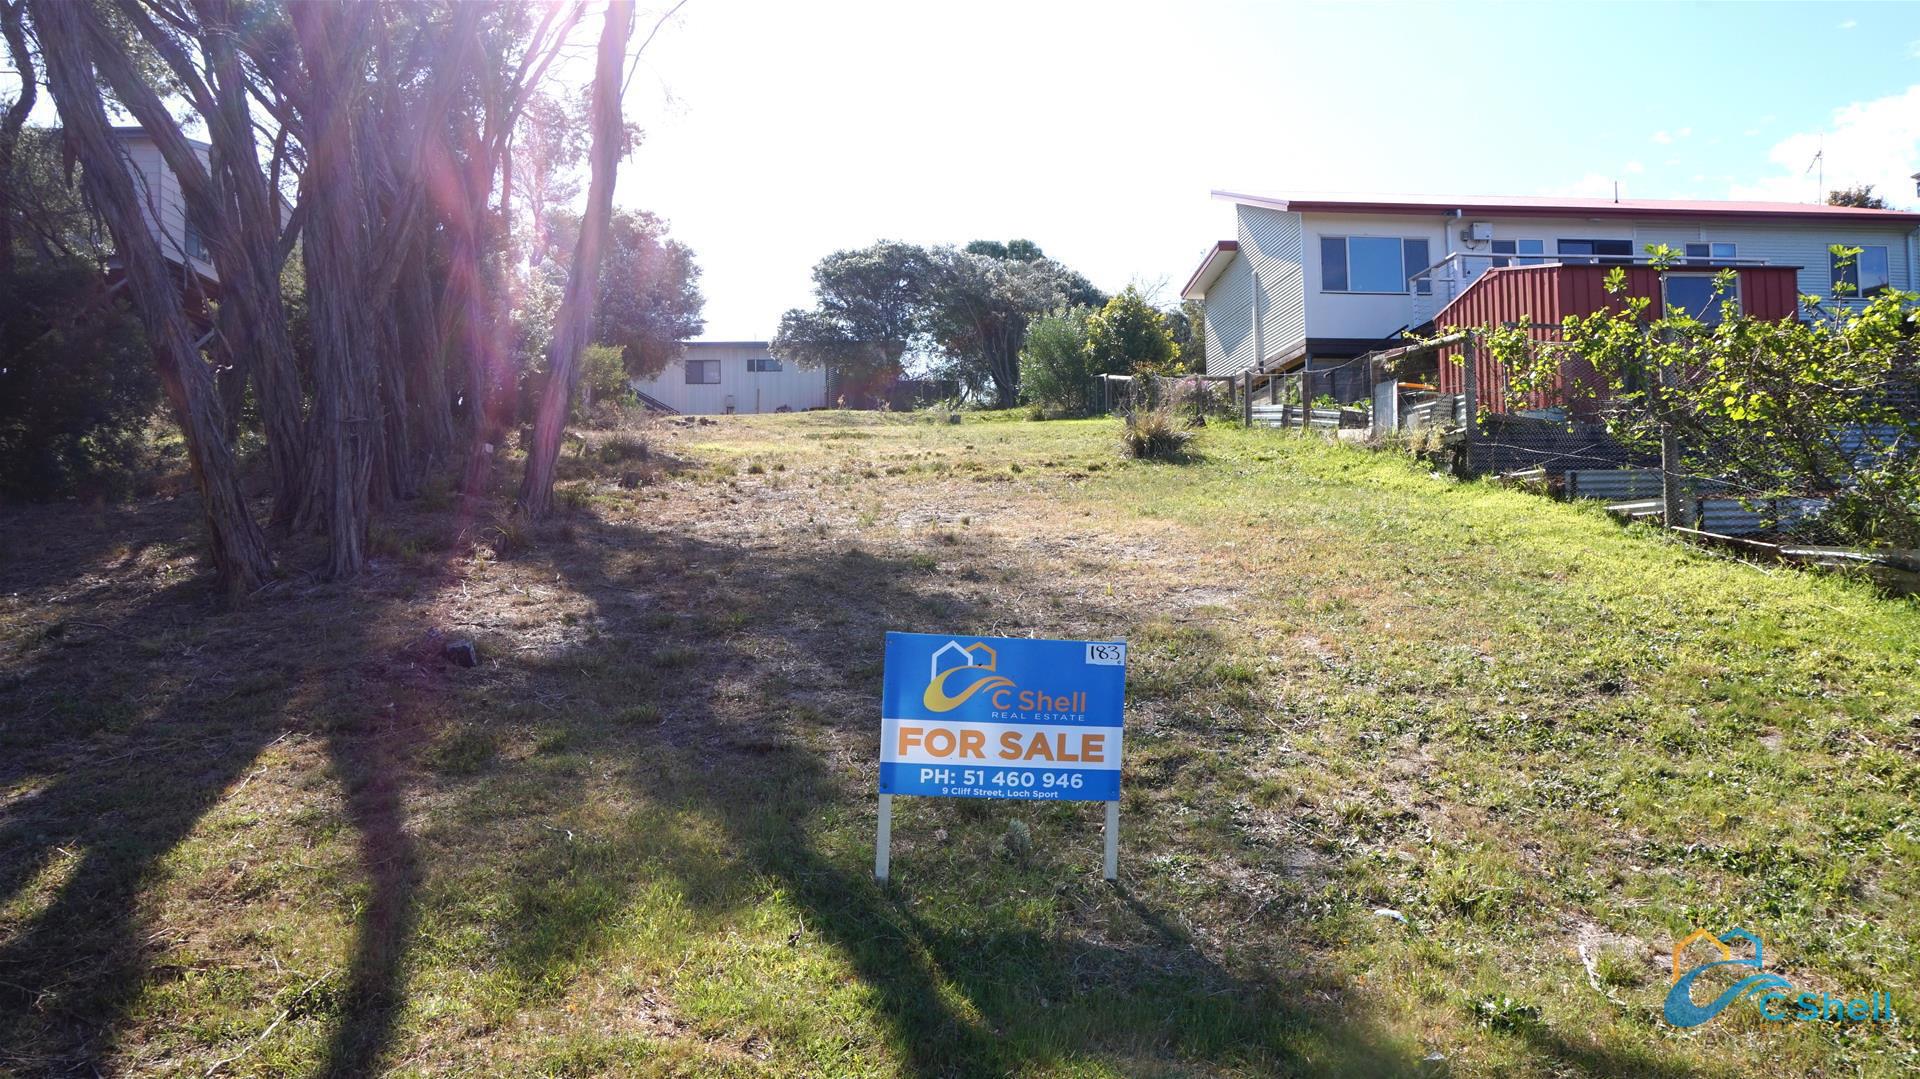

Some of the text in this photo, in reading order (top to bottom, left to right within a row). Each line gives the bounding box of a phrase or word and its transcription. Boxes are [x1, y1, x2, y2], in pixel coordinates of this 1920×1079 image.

[1091, 645, 1120, 660] 183
[992, 690, 1087, 712] C Shell
[992, 711, 1085, 722] REAL ESTATE
[898, 727, 1105, 763] FOR SALE
[920, 768, 1083, 789] PH: 51 460 946
[942, 787, 1058, 799] 9 Cliff Street, Loch Sport
